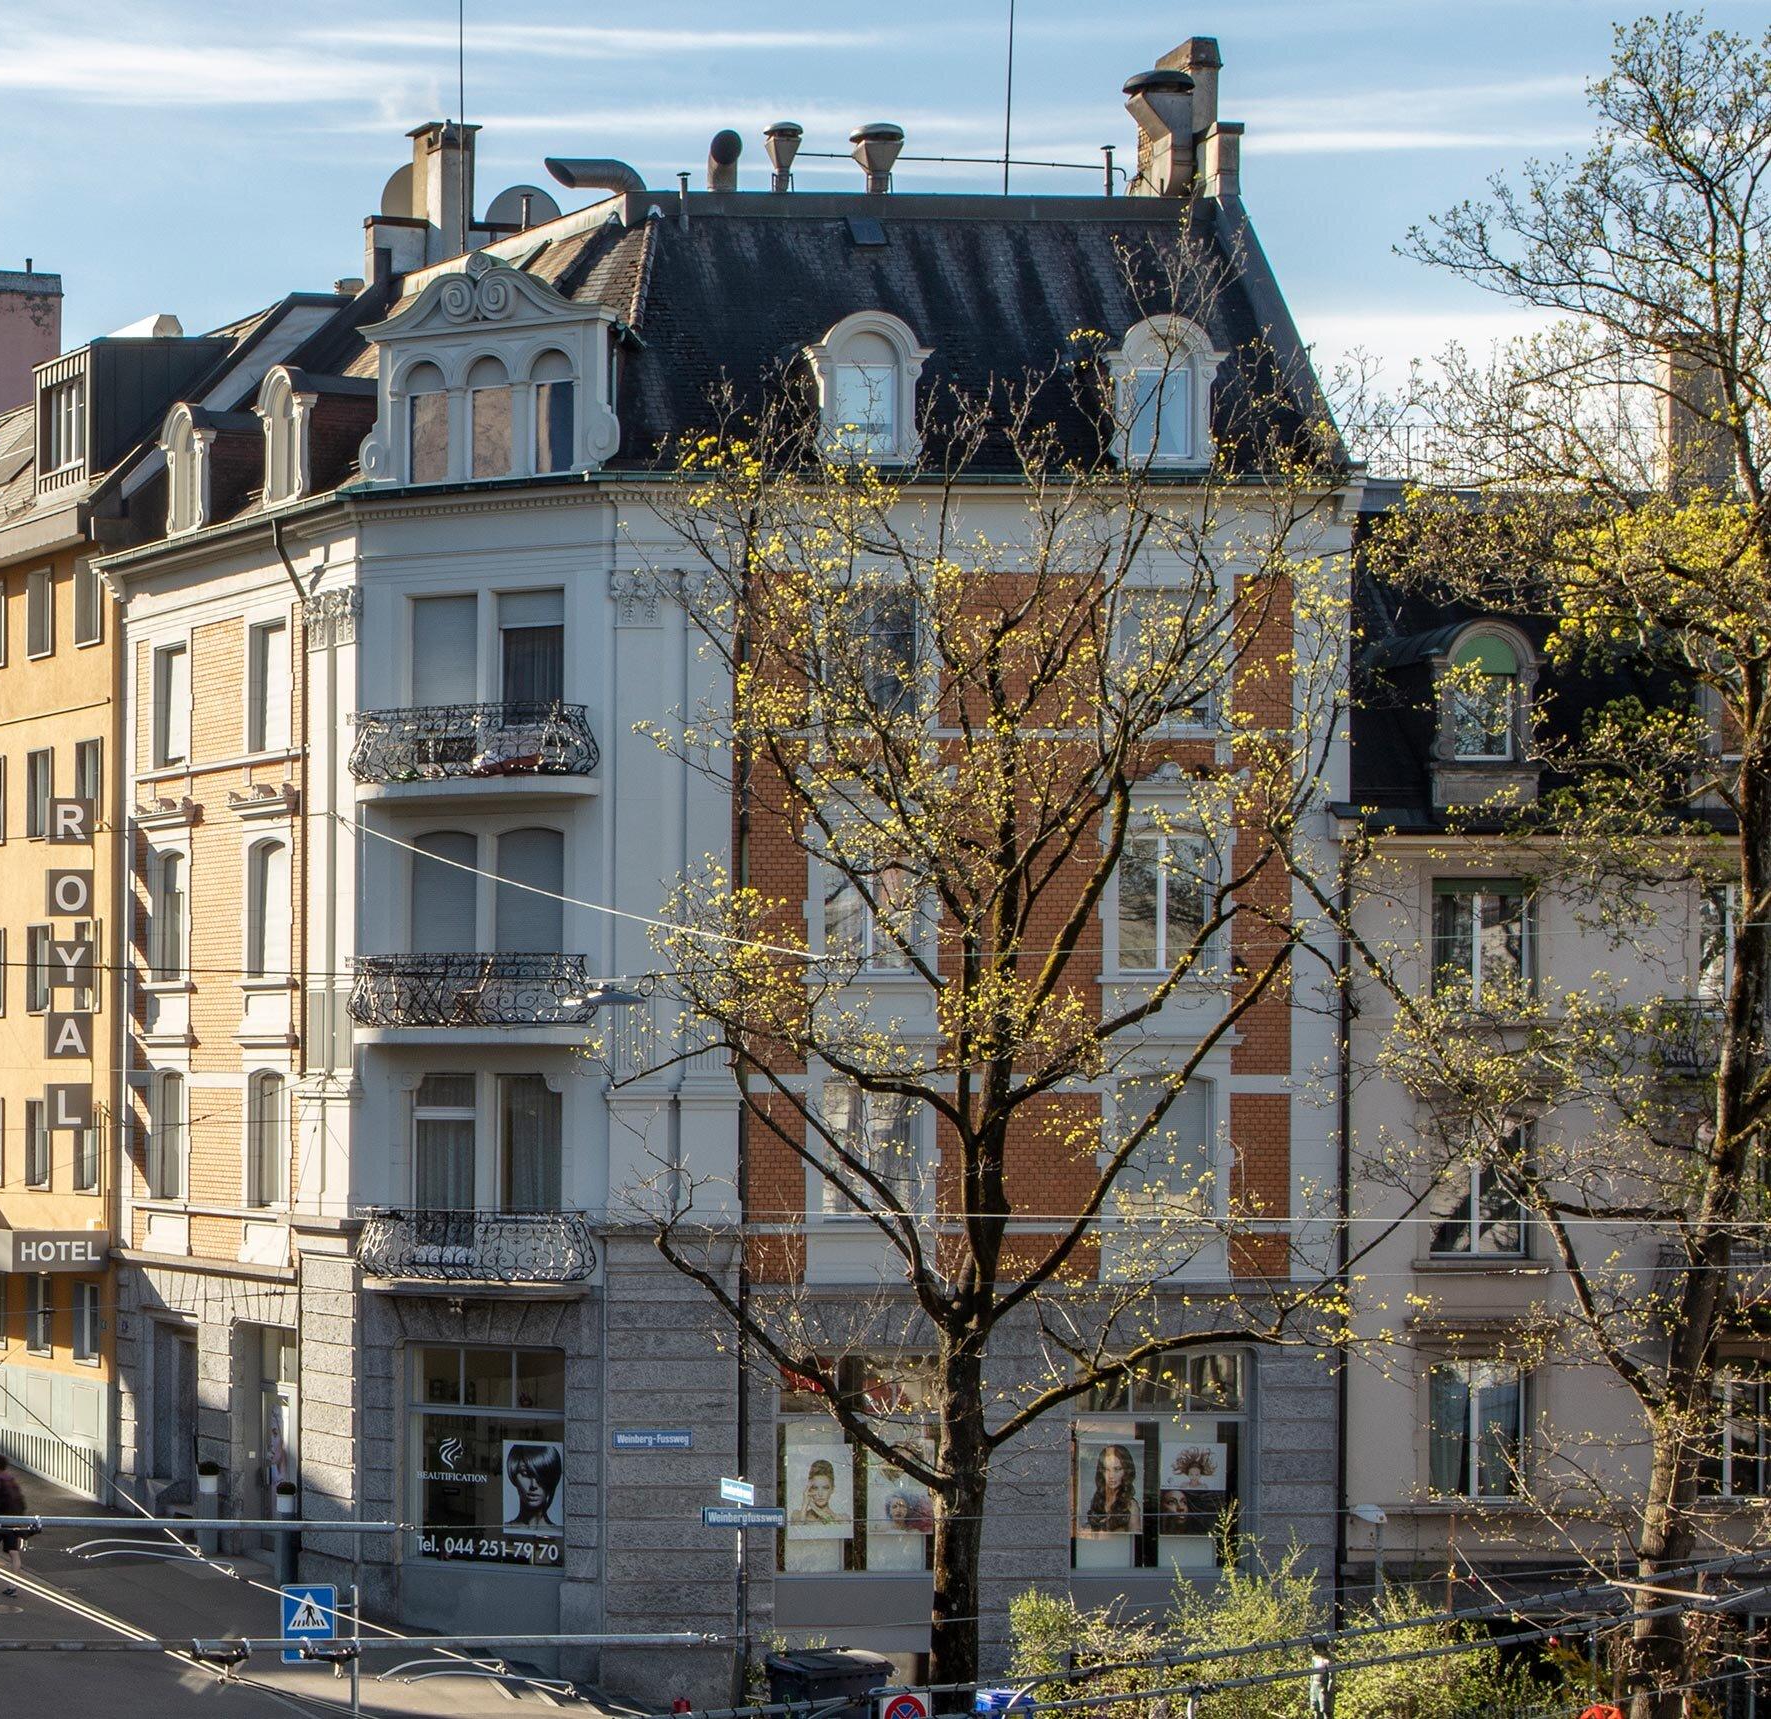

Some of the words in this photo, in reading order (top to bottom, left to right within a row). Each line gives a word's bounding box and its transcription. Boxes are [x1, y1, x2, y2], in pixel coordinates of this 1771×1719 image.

[54, 804, 88, 1126] ROYAL
[21, 1241, 101, 1262] HOTEL
[616, 1433, 690, 1446] Weinberg-Fussweg
[416, 1470, 488, 1483] BEAUTIFICATION
[708, 1511, 783, 1526] Weinbergfussweg
[417, 1534, 440, 1553] Tel.
[444, 1536, 475, 1554] 044
[479, 1539, 507, 1557] 251
[513, 1541, 534, 1559] 79
[538, 1543, 559, 1561] 70
